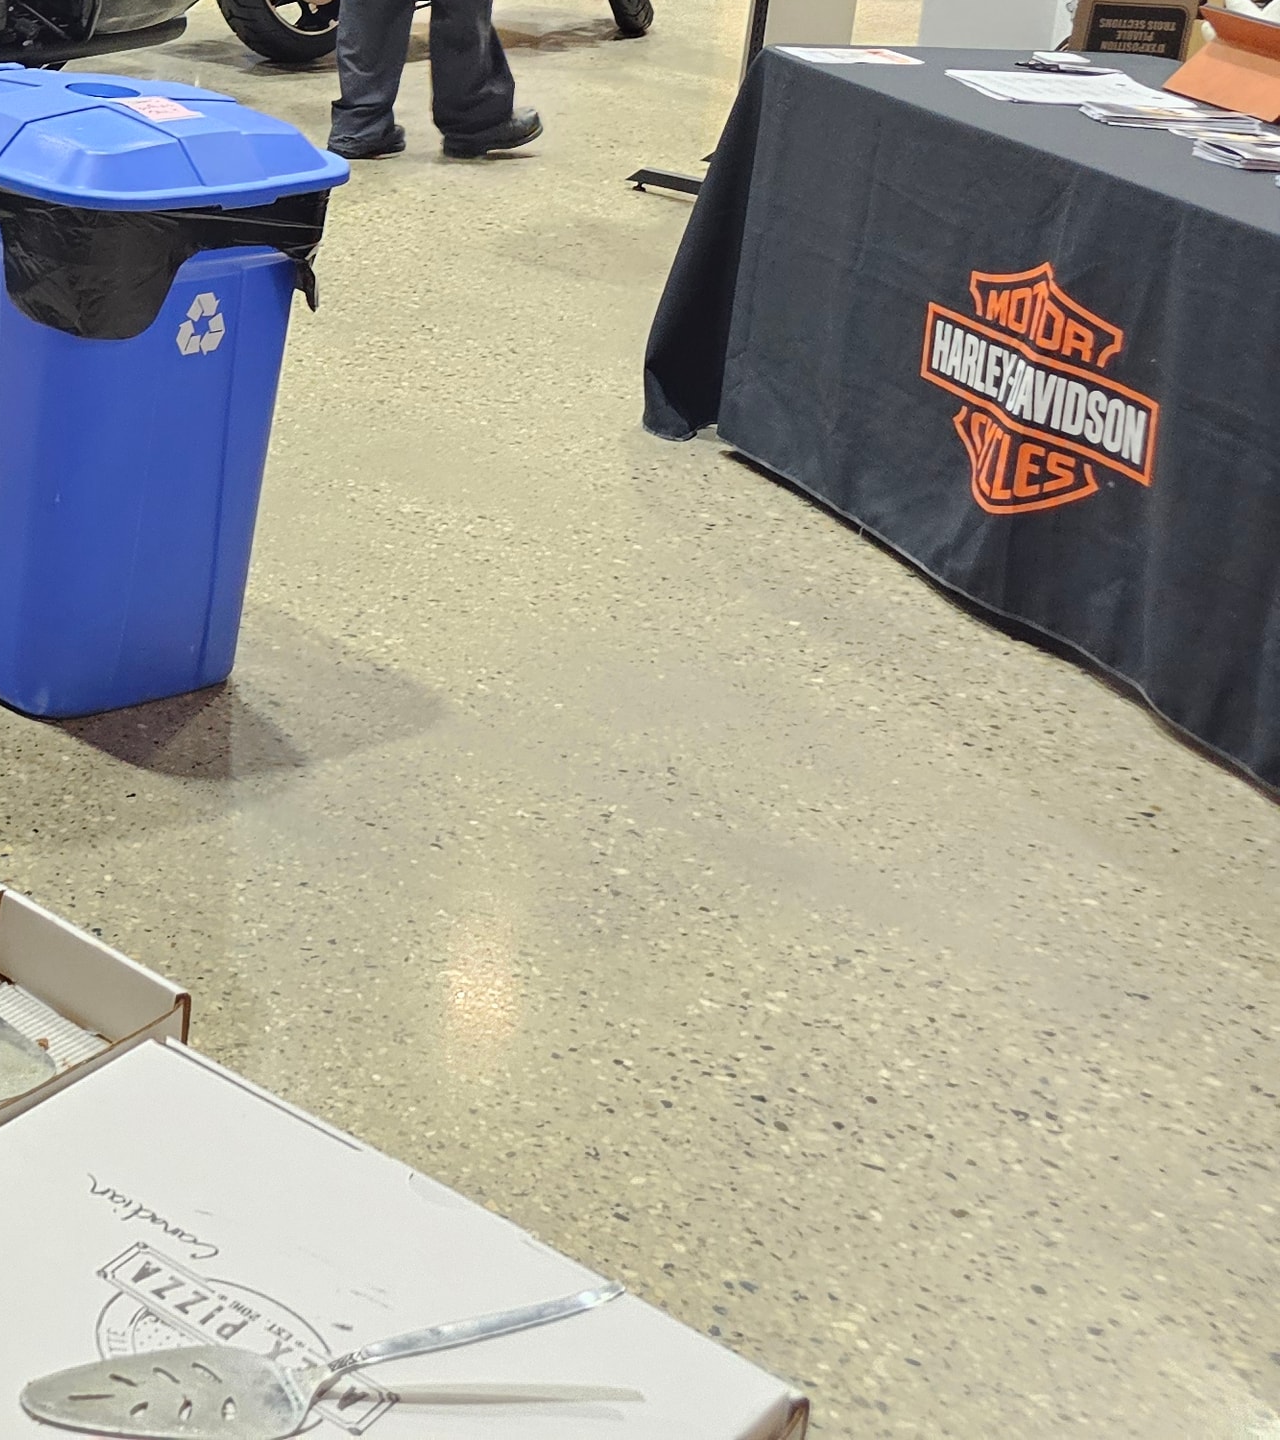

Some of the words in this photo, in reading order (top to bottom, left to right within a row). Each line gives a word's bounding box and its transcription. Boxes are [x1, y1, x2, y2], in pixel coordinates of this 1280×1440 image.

[1098, 18, 1146, 31] SECTIONS
[1099, 40, 1166, 53] D'EXPOSITION
[1115, 30, 1155, 42] PLIABLE
[1148, 20, 1177, 32] TROIS
[986, 280, 1095, 363] MOTOR
[931, 320, 1147, 465] HARLEY-DAVIDSON
[970, 412, 1076, 500] CYCLES
[86, 1172, 219, 1260] Canadian
[131, 1261, 249, 1341] PIZZA
